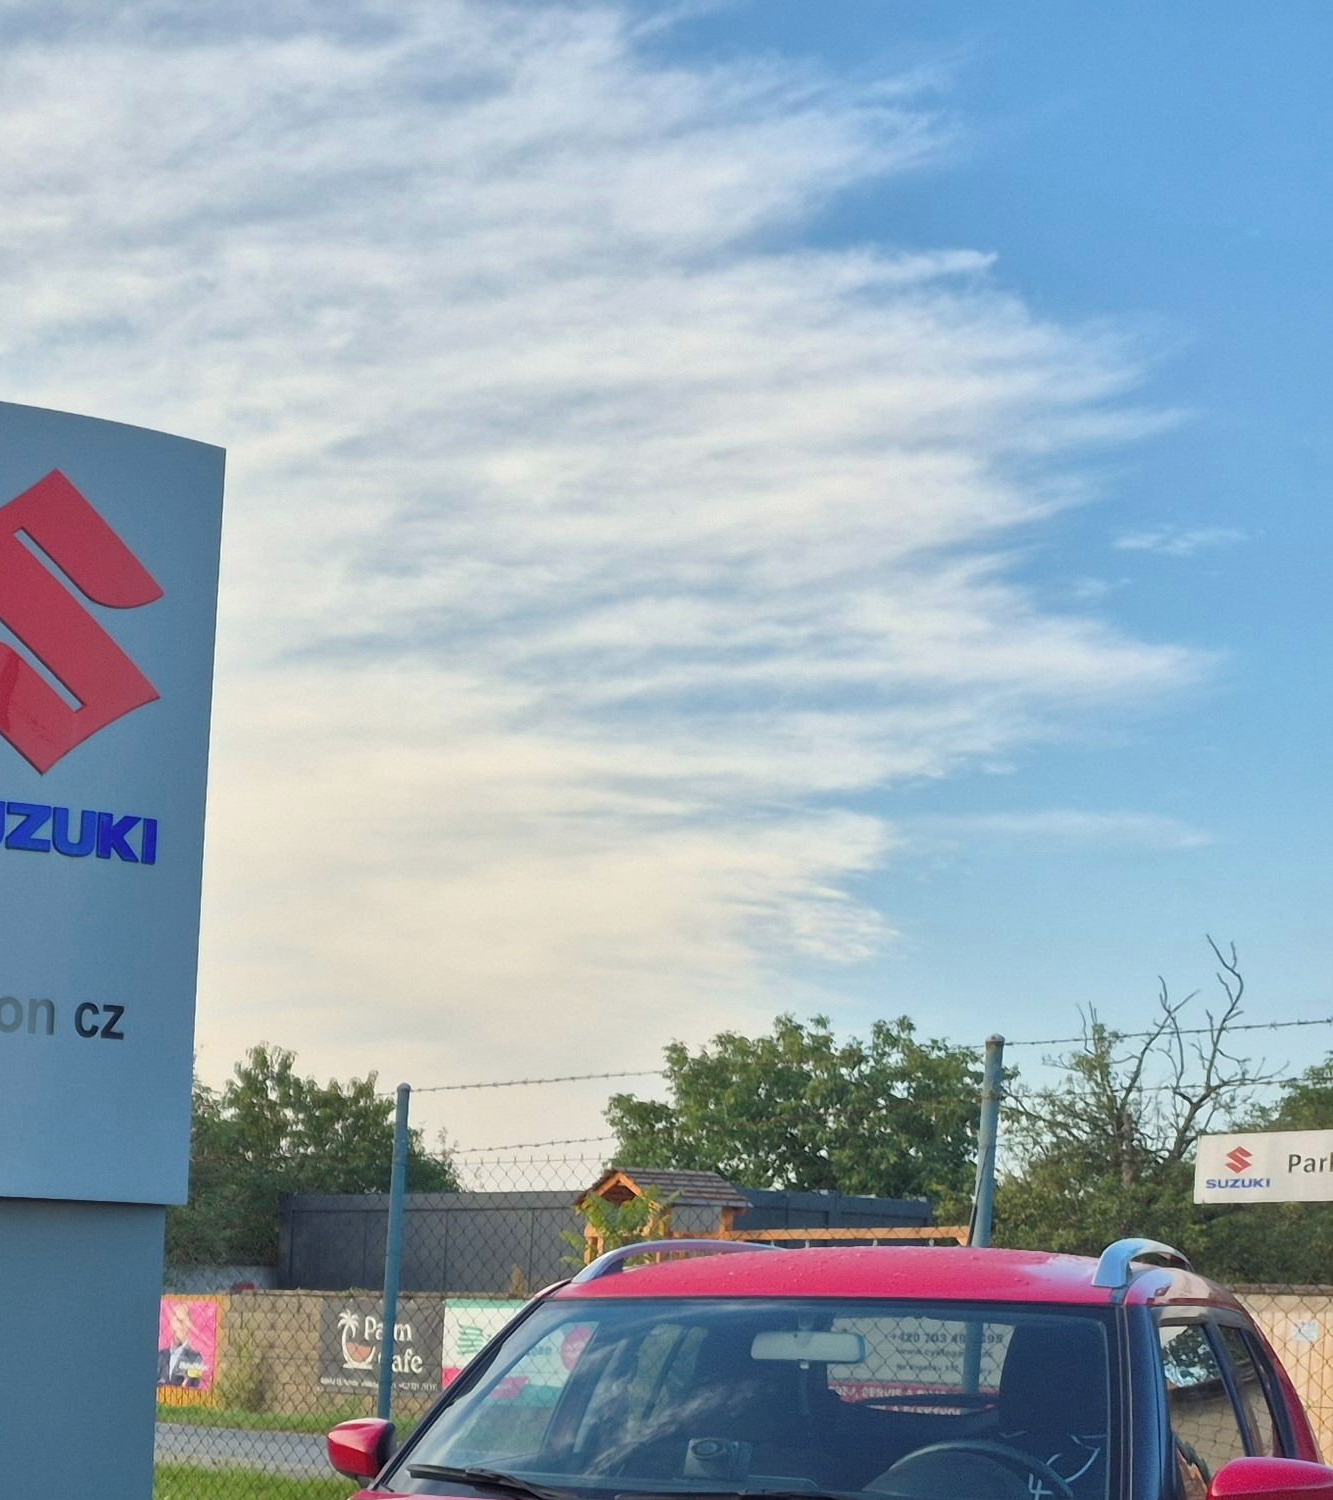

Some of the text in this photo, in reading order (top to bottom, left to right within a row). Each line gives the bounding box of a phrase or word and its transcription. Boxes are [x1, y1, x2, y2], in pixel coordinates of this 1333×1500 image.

[1205, 1178, 1271, 1189] SUZUKI
[363, 1315, 413, 1343] Pam
[377, 1348, 424, 1374] afe
